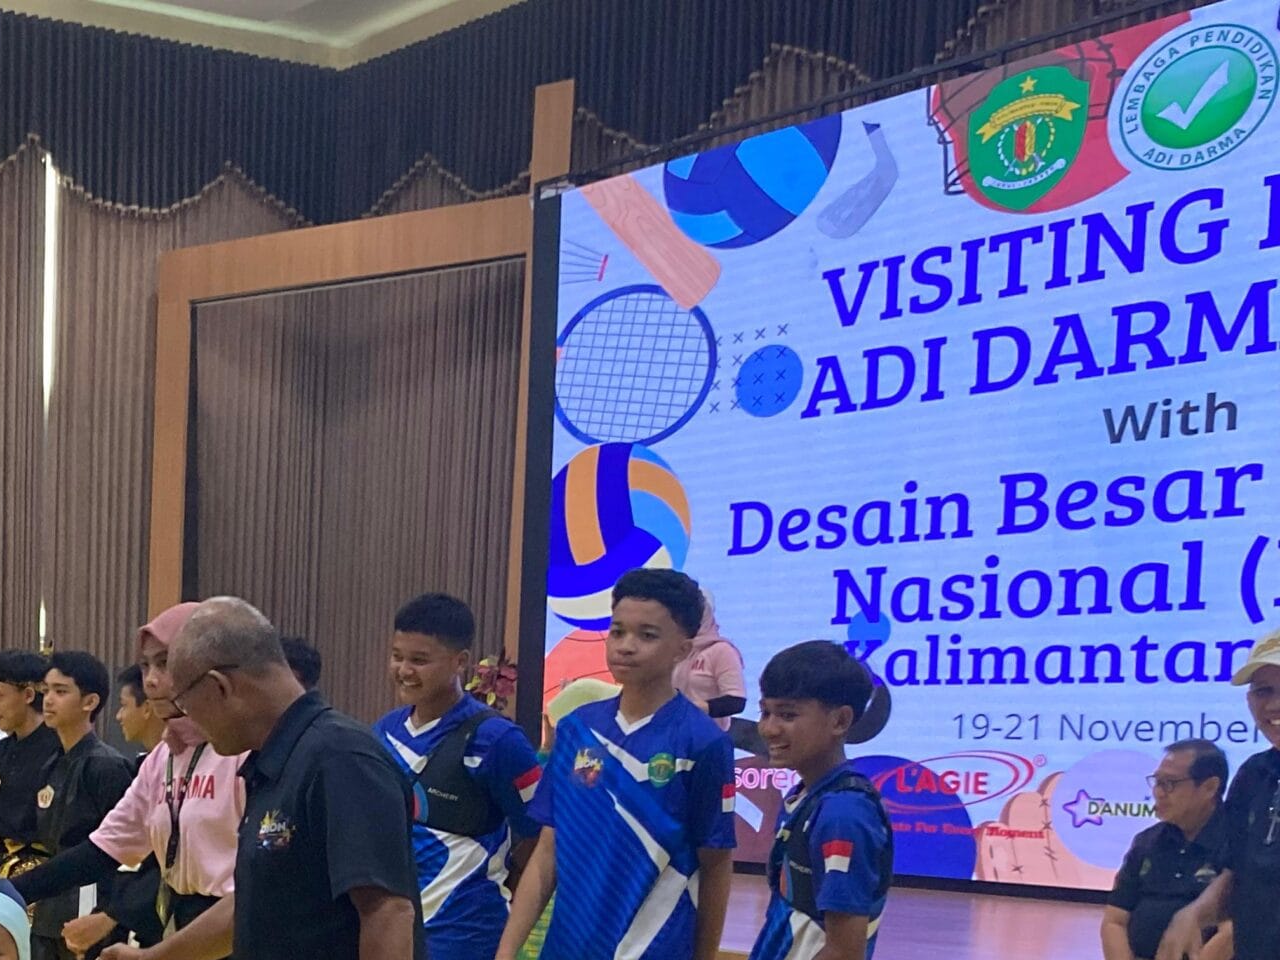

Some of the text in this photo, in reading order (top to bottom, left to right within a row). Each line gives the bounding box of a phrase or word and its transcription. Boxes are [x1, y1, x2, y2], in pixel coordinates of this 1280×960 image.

[1126, 29, 1274, 134] LEMBAGA PENDIDIKAN
[1143, 127, 1247, 166] ADI DARMA
[822, 187, 1230, 327] VISITING
[800, 278, 1280, 419] ADI DARM
[1103, 391, 1238, 444] With
[728, 463, 1263, 556] Desain Besar
[831, 540, 1206, 625] Nasional
[952, 712, 1041, 741] 19-21
[895, 766, 989, 795] L'AGIE
